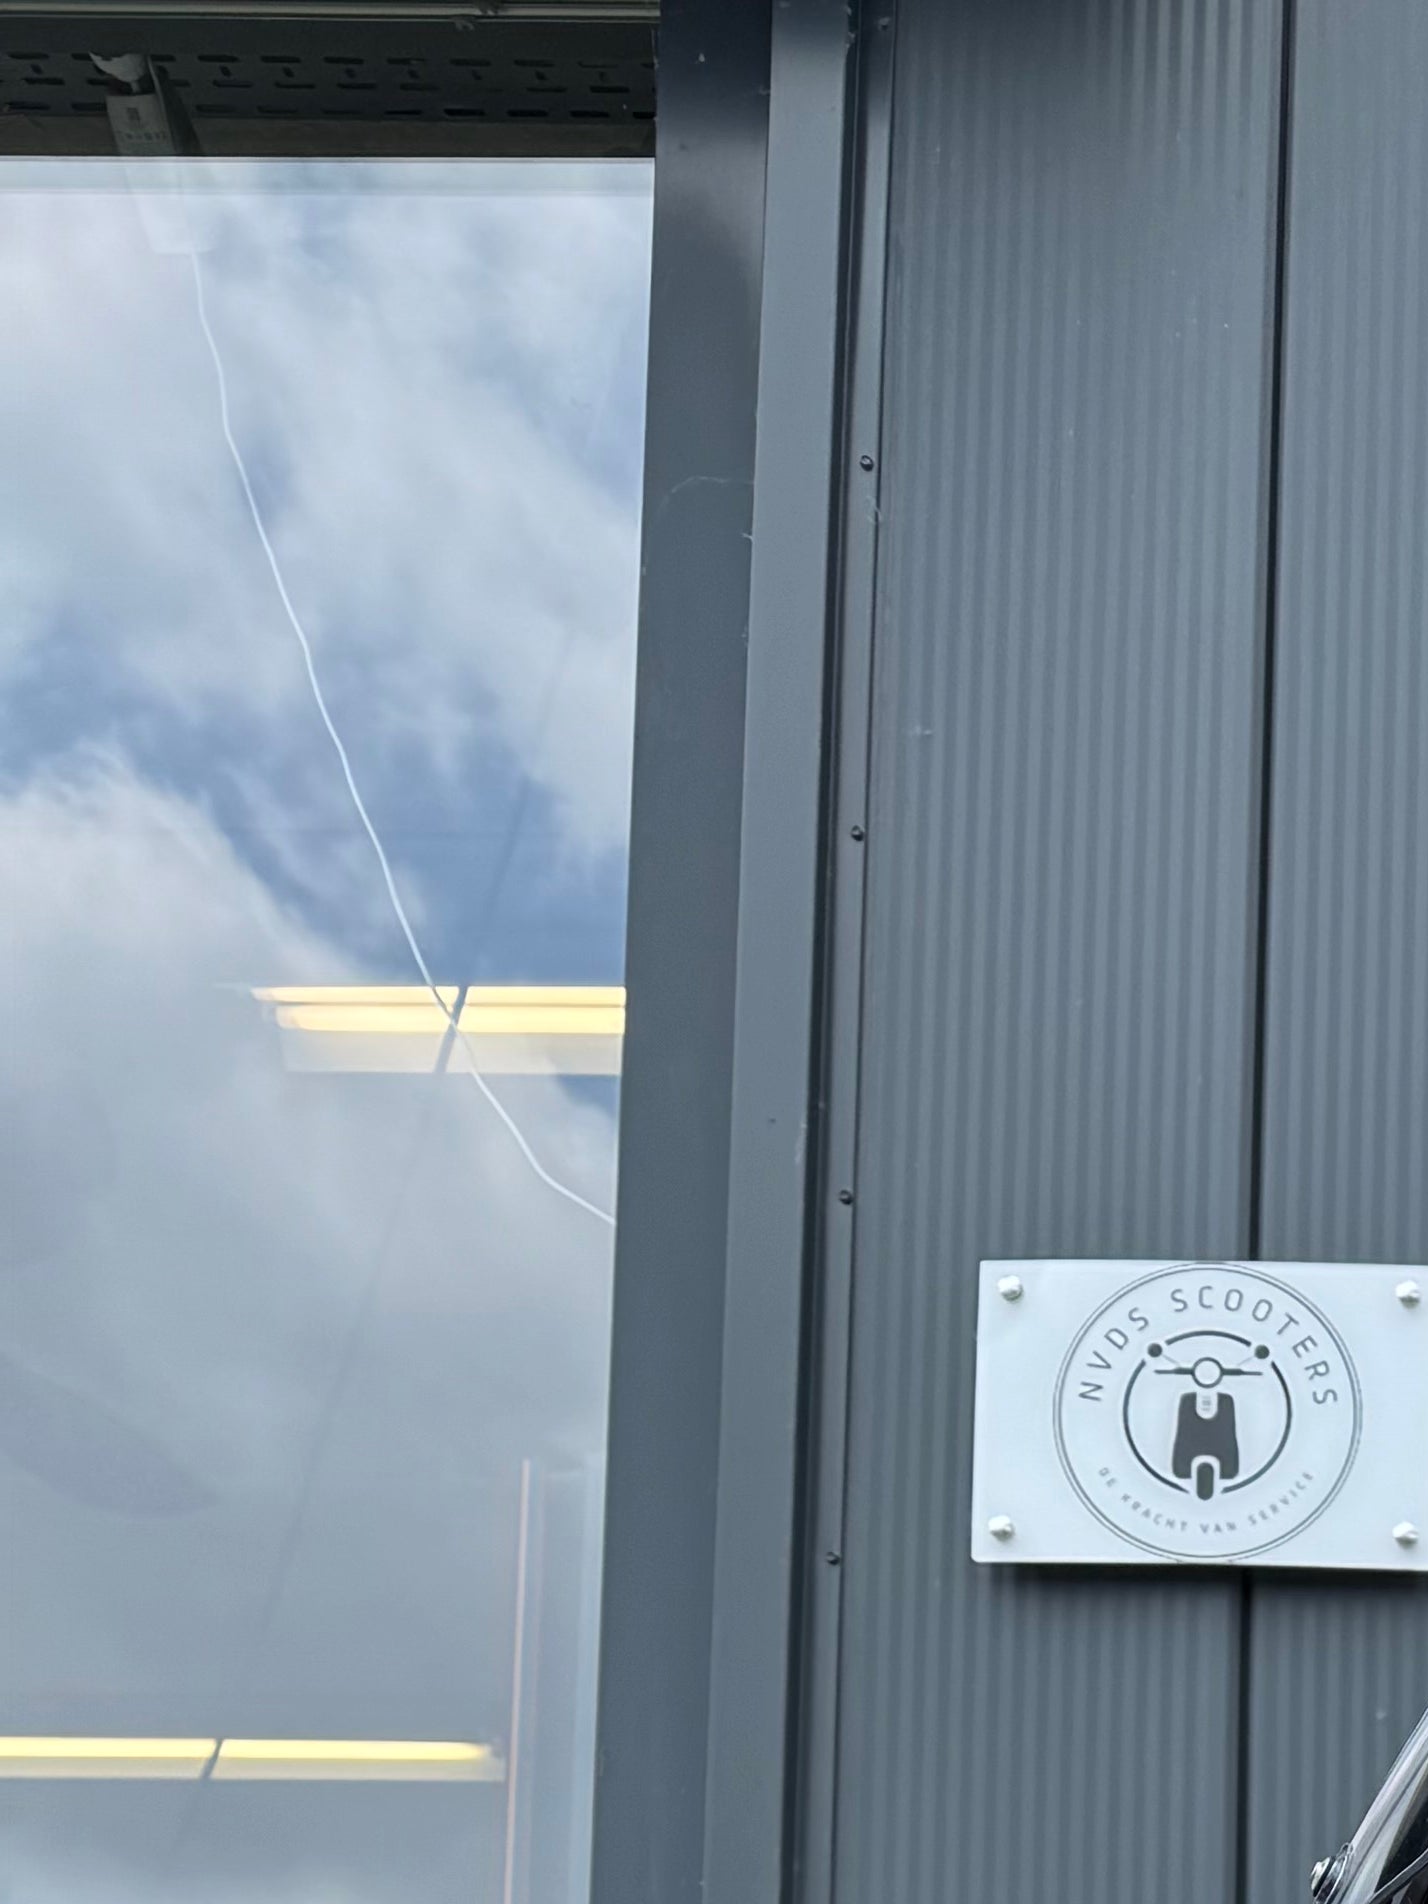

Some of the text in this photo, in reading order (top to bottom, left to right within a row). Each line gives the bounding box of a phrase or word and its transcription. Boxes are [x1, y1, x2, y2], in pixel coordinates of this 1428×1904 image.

[1078, 1284, 1338, 1407] NVDS SCOOTERS
[1199, 1520, 1239, 1535] VAN
[1248, 1470, 1316, 1529] SERVICE
